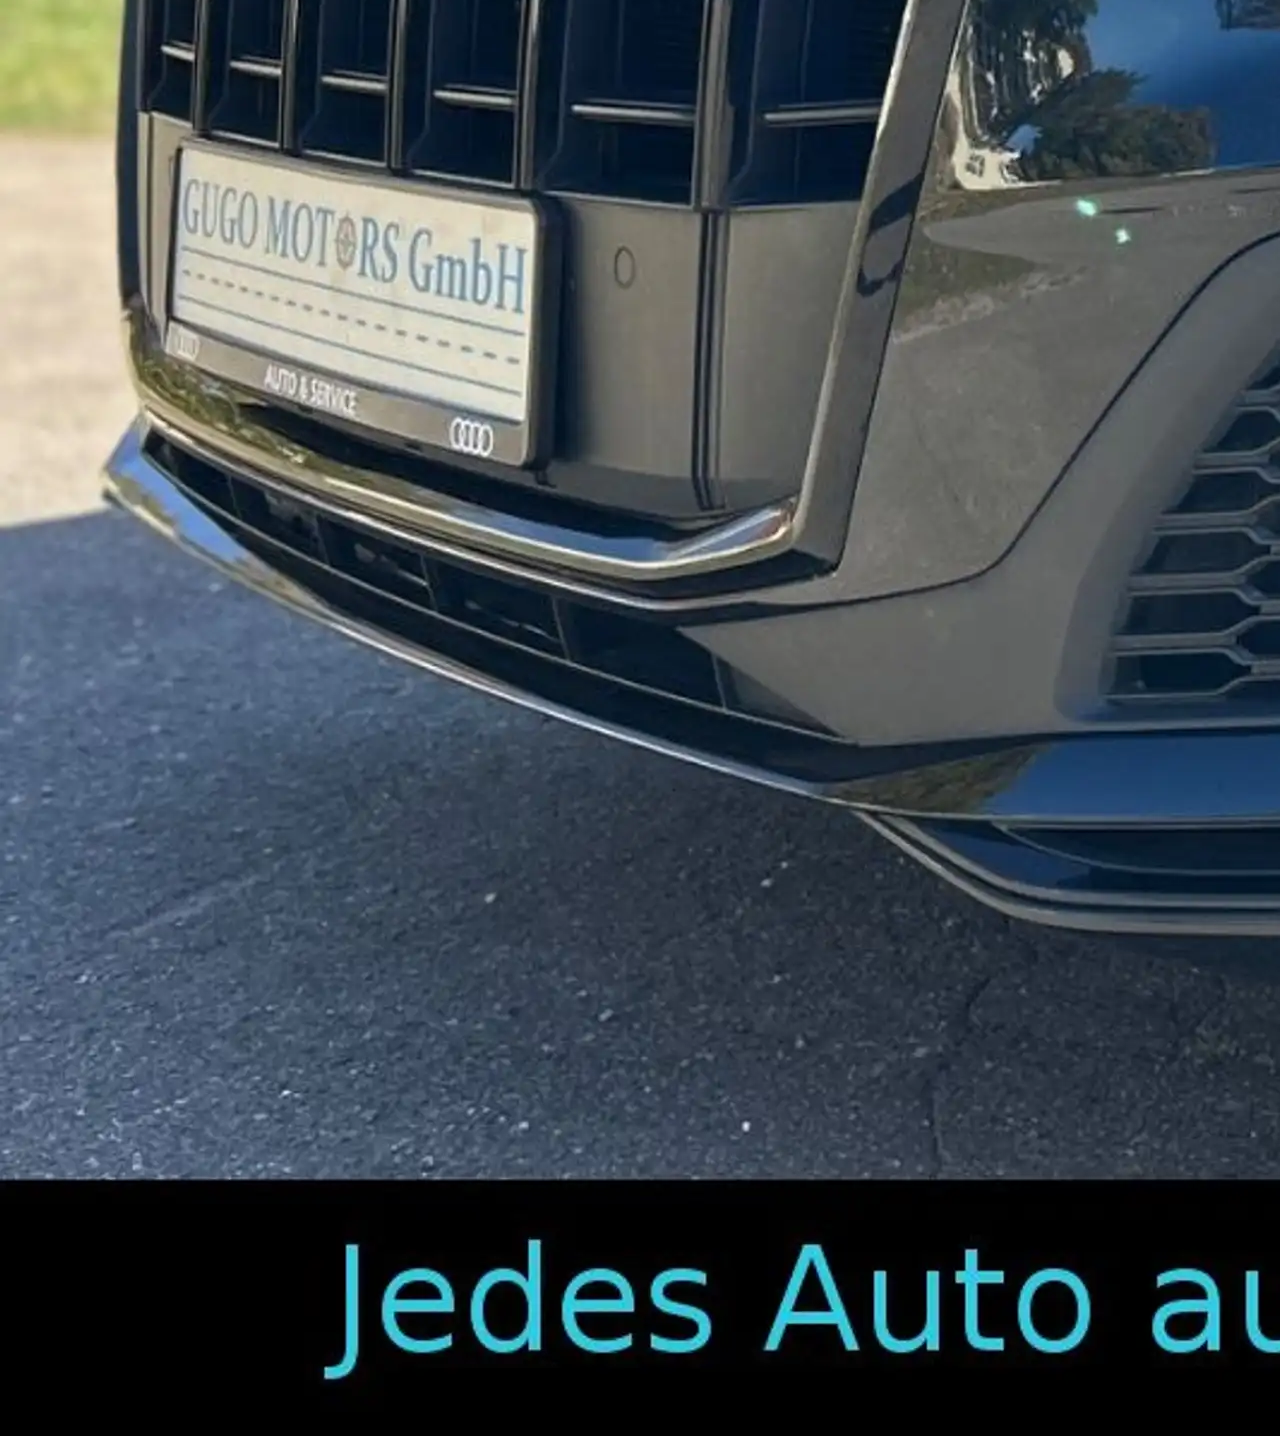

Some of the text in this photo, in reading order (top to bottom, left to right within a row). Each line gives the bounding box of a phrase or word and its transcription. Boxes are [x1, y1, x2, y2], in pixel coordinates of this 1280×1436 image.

[183, 178, 528, 315] GUGO MOTORS GmbH
[264, 364, 298, 396] AUTO
[311, 378, 358, 417] SERVICE
